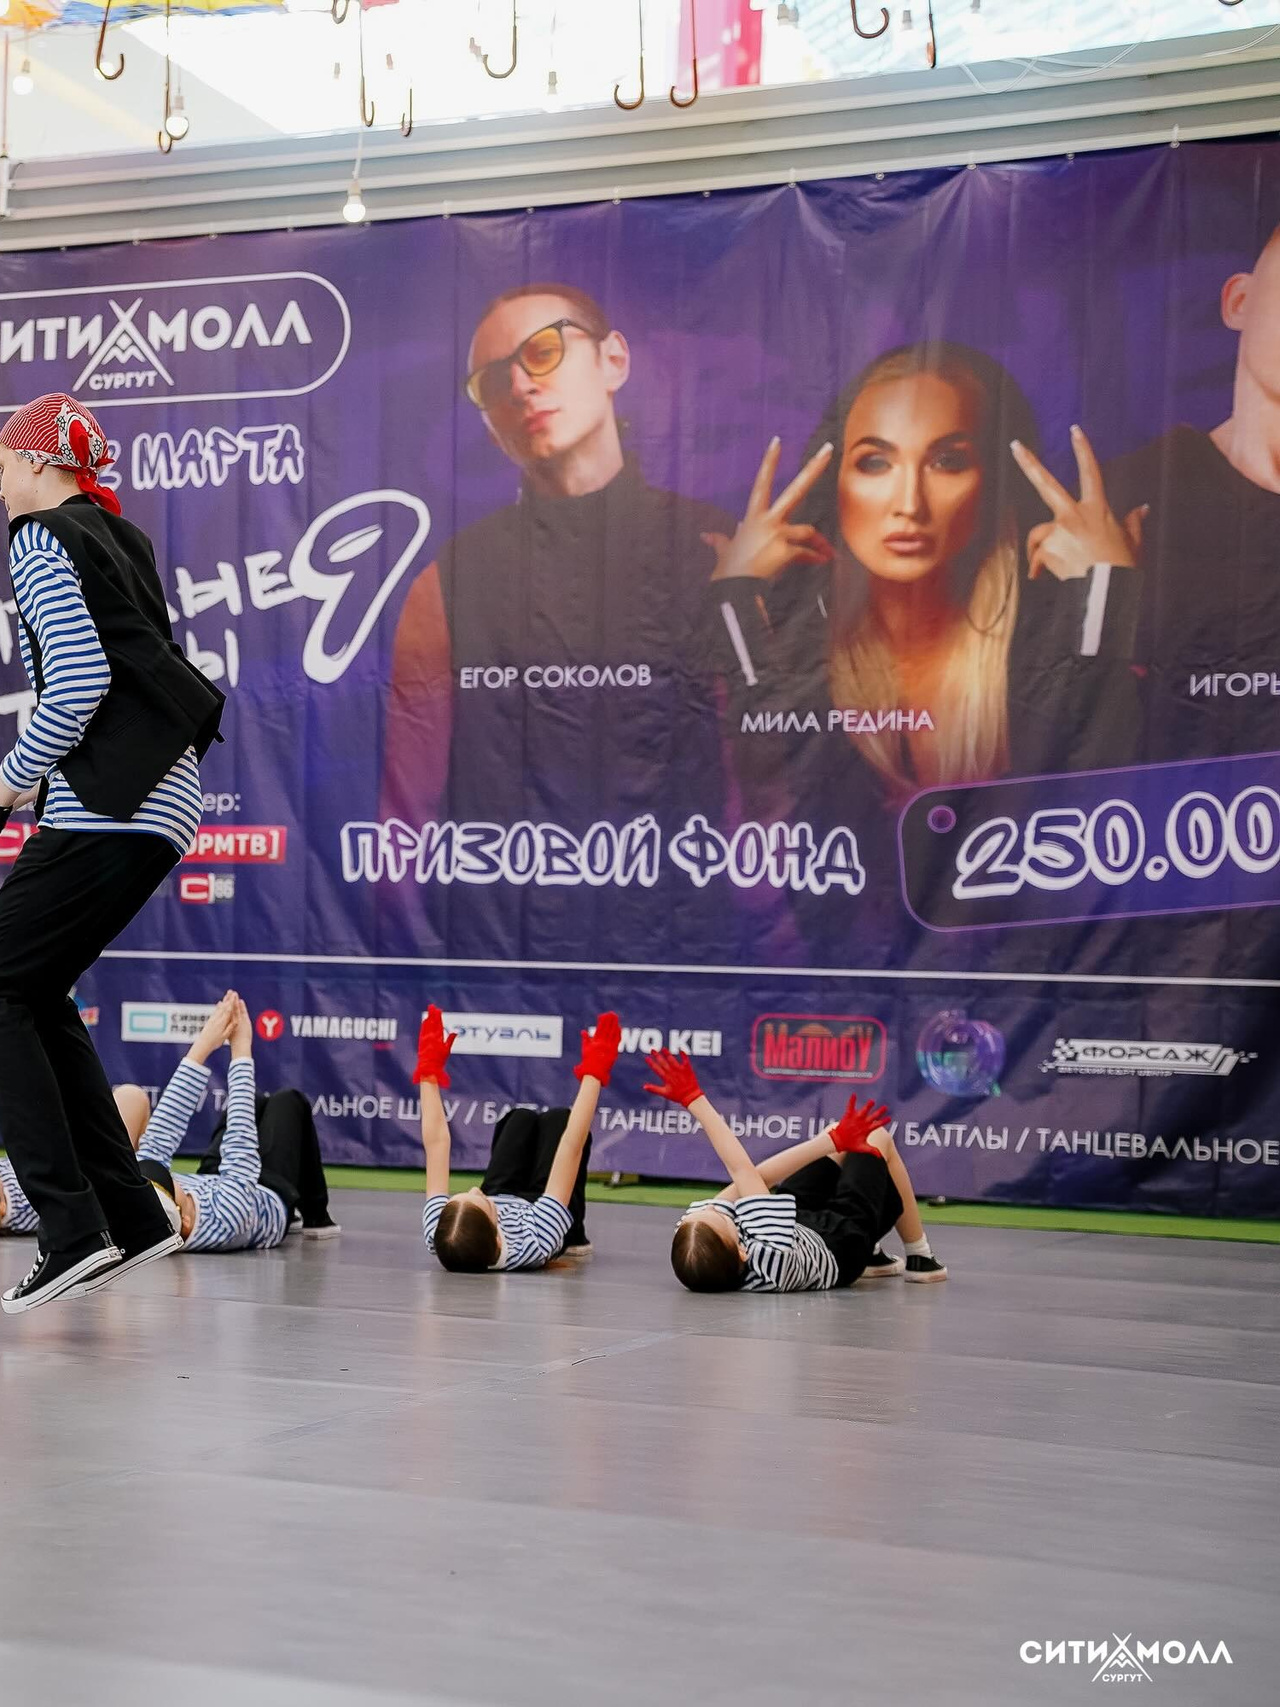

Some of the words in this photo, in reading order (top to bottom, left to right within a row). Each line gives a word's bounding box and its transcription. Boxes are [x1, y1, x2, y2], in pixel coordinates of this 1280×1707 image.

[147, 300, 313, 352] МОЛЛ
[88, 370, 159, 391] СУРГУТ
[131, 423, 306, 491] МАРТА
[460, 668, 518, 688] ЕГОР
[523, 664, 652, 688] СОКОЛОВ
[741, 711, 820, 733] МИЛА
[827, 709, 935, 735] РЕДИНА
[340, 814, 661, 888] ПРИЗОВОЙ
[669, 814, 866, 896] ФОНД
[290, 1015, 397, 1041] YAMAGUCHI
[669, 1030, 722, 1056] KEI
[1082, 1046, 1211, 1063] ФОРСАЖ
[1036, 1128, 1280, 1166] ТАНЦЕВАЛЬНОЕ
